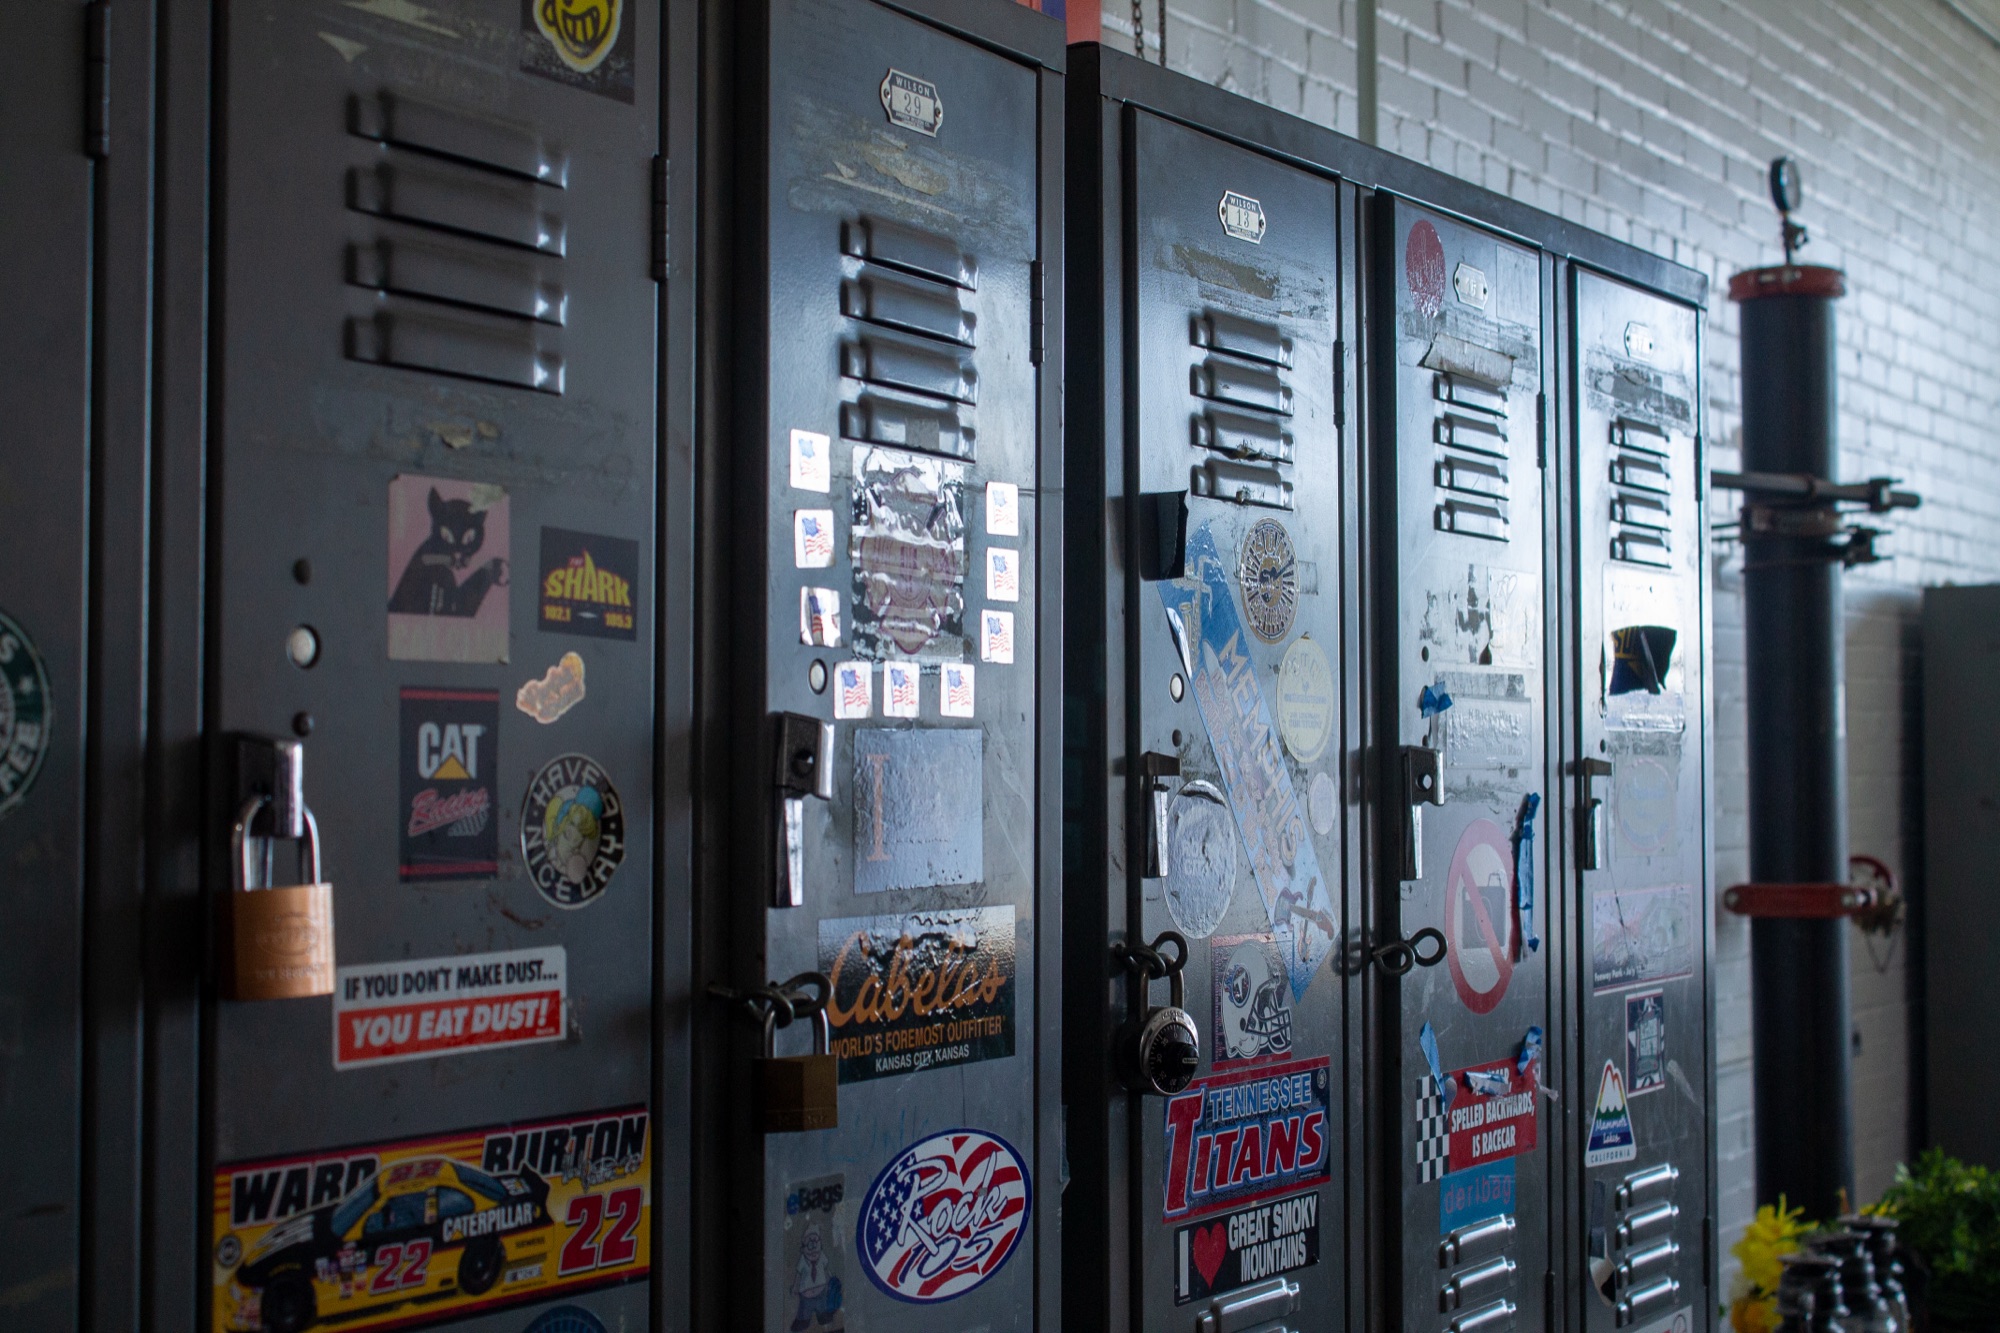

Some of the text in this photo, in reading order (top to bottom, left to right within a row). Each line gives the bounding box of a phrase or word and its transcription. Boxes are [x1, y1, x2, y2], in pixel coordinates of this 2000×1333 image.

[895, 76, 930, 97] WILSON
[904, 92, 921, 117] 29
[1230, 196, 1257, 212] WILSON
[1236, 209, 1250, 229] 13
[545, 550, 632, 607] SHARK
[417, 722, 484, 779] CAT
[1219, 628, 1304, 866] MEMPHIS
[525, 760, 625, 901] HAVE A NICE DAY
[345, 959, 558, 1001] IF YOU DON'T MAKE DUST...
[351, 997, 550, 1049] YOU EAT DUST!
[830, 1018, 1003, 1060] WORLD'S FOREMOST OUTFITTER
[875, 1055, 912, 1073] KANSAS
[935, 1044, 970, 1062] KANSAS
[1209, 1072, 1312, 1122] TENNESSEE
[1451, 1090, 1535, 1134] SPELLED BACKWARDS,
[481, 1111, 650, 1177] BURTON
[1164, 1088, 1325, 1218] TITANS
[1472, 1125, 1517, 1159] IS RACECAR
[1590, 1148, 1631, 1163] CALIFORNIA
[231, 1153, 381, 1230] WARD
[786, 1182, 843, 1214] eBags
[896, 1150, 1008, 1256] Rock
[442, 1201, 534, 1242] CATERPILLAR
[556, 1185, 645, 1278] 22
[1179, 1193, 1318, 1299] I GREAT SMOKY
[369, 1237, 433, 1295] 22
[1240, 1234, 1307, 1283] MOUNTAINS
